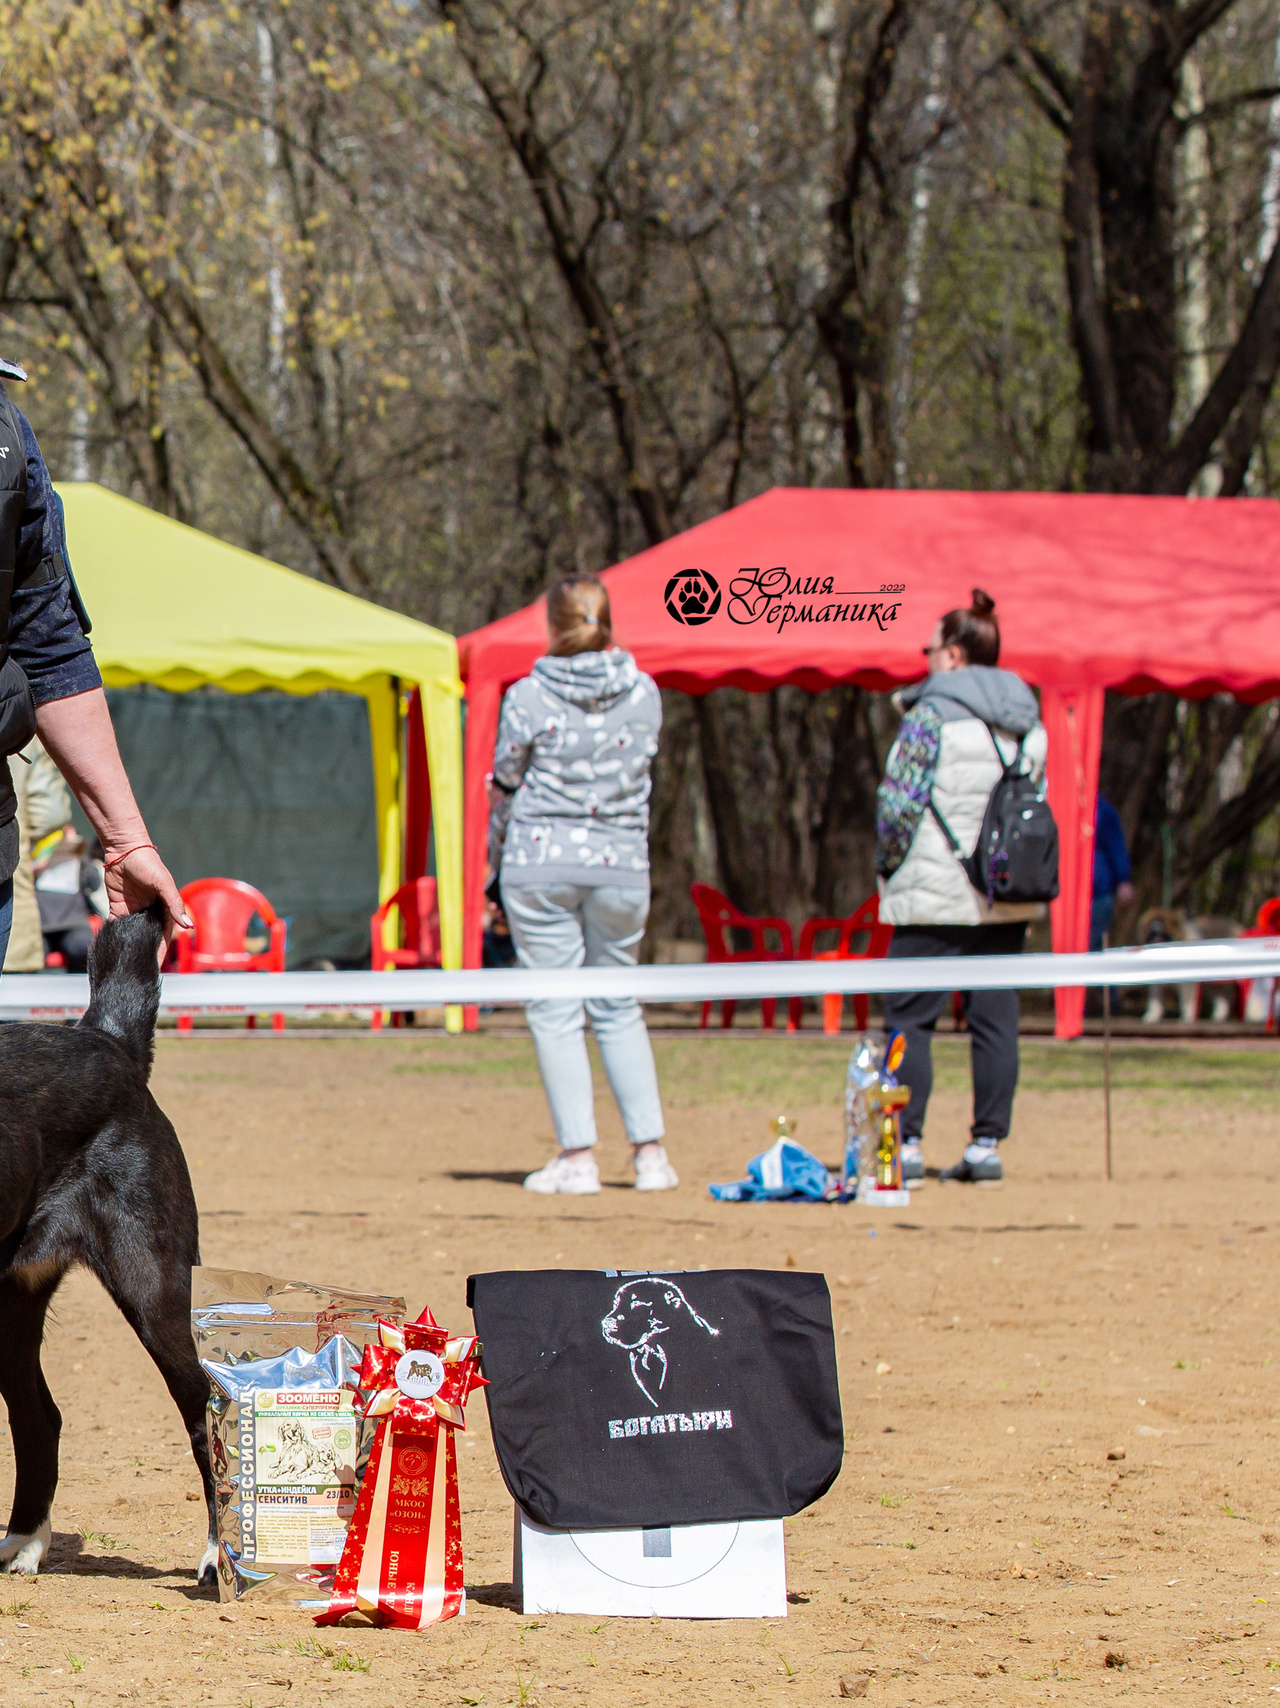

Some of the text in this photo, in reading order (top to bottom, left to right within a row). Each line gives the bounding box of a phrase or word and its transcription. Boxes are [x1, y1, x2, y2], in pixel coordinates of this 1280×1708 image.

[278, 1393, 340, 1403] ЗООМЕНЮ
[608, 1410, 732, 1439] БОГАТЫРИ
[240, 1391, 255, 1560] ПРОФЕССИОНАЛ
[258, 1485, 317, 1494] УТКА+ИНДЕЙКА
[326, 1491, 350, 1499] 23/10
[258, 1496, 308, 1504] СЕНСИТИВ
[395, 1499, 425, 1508] МКОО
[389, 1511, 426, 1519] «ОЗОН»
[388, 1550, 400, 1589] ЮНЫЕ
